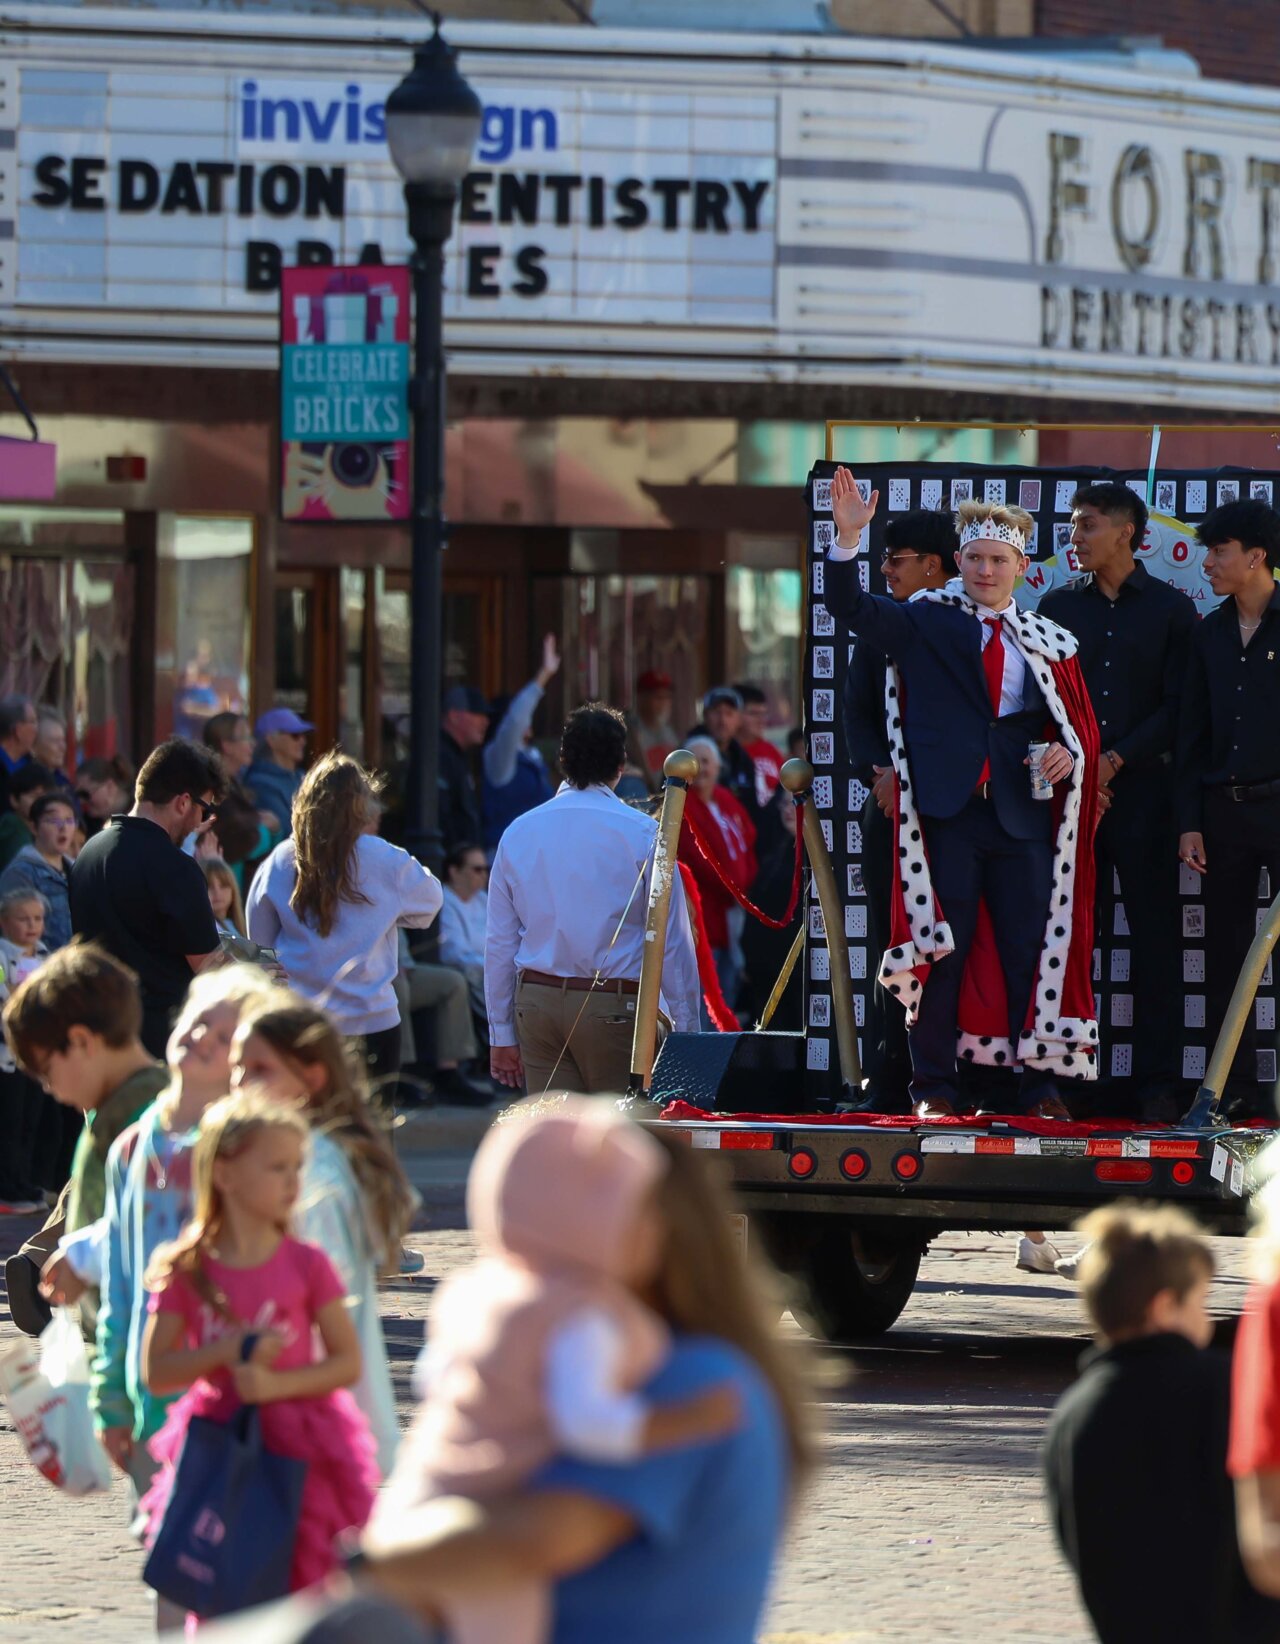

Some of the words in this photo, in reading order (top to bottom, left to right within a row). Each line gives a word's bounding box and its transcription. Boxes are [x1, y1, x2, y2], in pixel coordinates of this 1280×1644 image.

[241, 79, 559, 163] invisgn
[33, 156, 347, 220] SEDATION
[460, 171, 770, 234] ENTISTRY
[246, 241, 549, 297] BES
[291, 350, 400, 382] CELEBRATE
[293, 394, 400, 434] BRICKS
